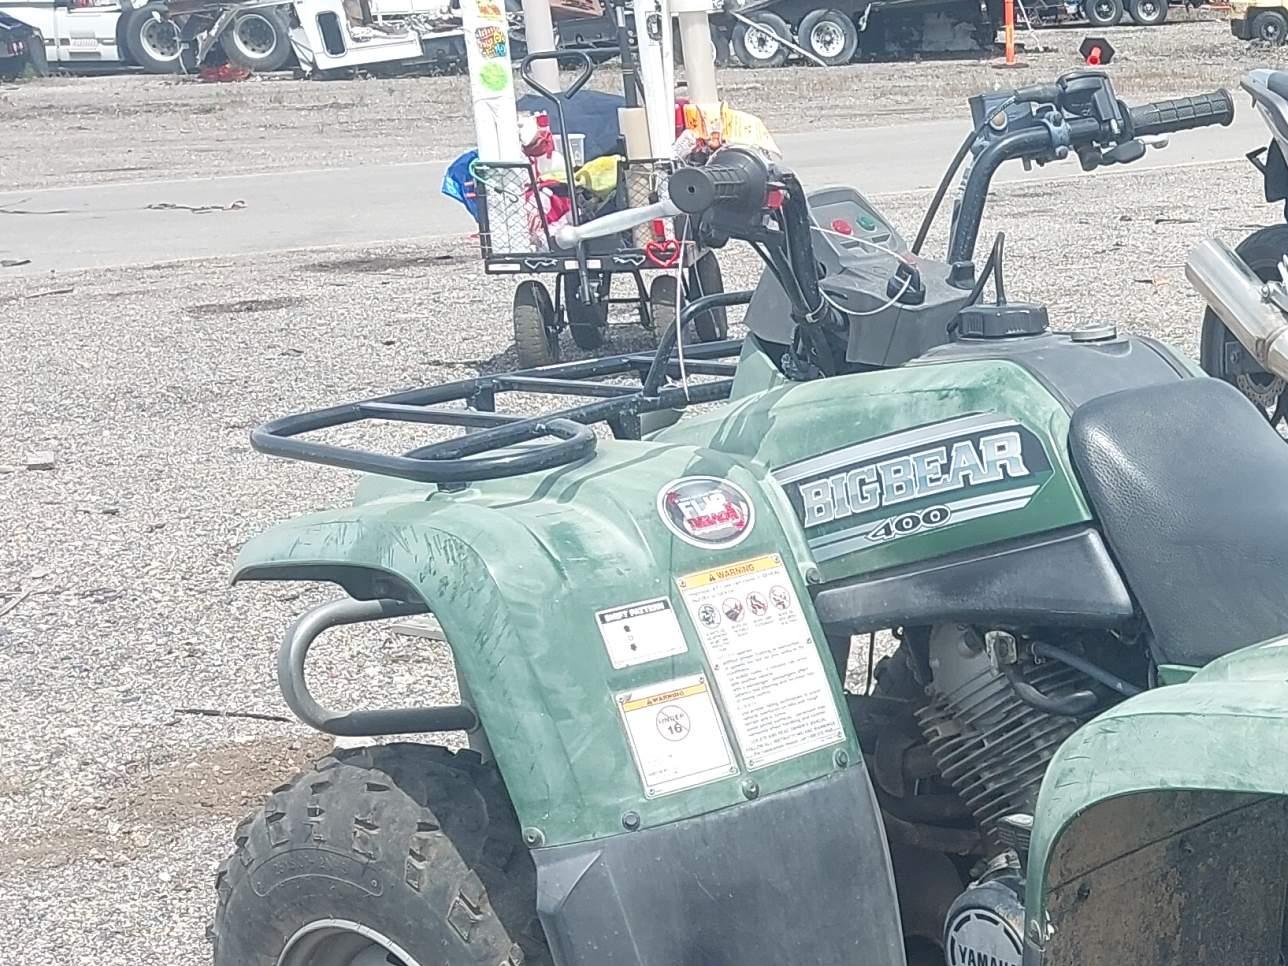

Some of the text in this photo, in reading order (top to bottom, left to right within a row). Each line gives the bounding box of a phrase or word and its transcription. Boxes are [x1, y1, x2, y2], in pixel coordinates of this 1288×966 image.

[864, 504, 952, 542] 400
[716, 563, 756, 580] WARNING
[666, 721, 683, 735] 16
